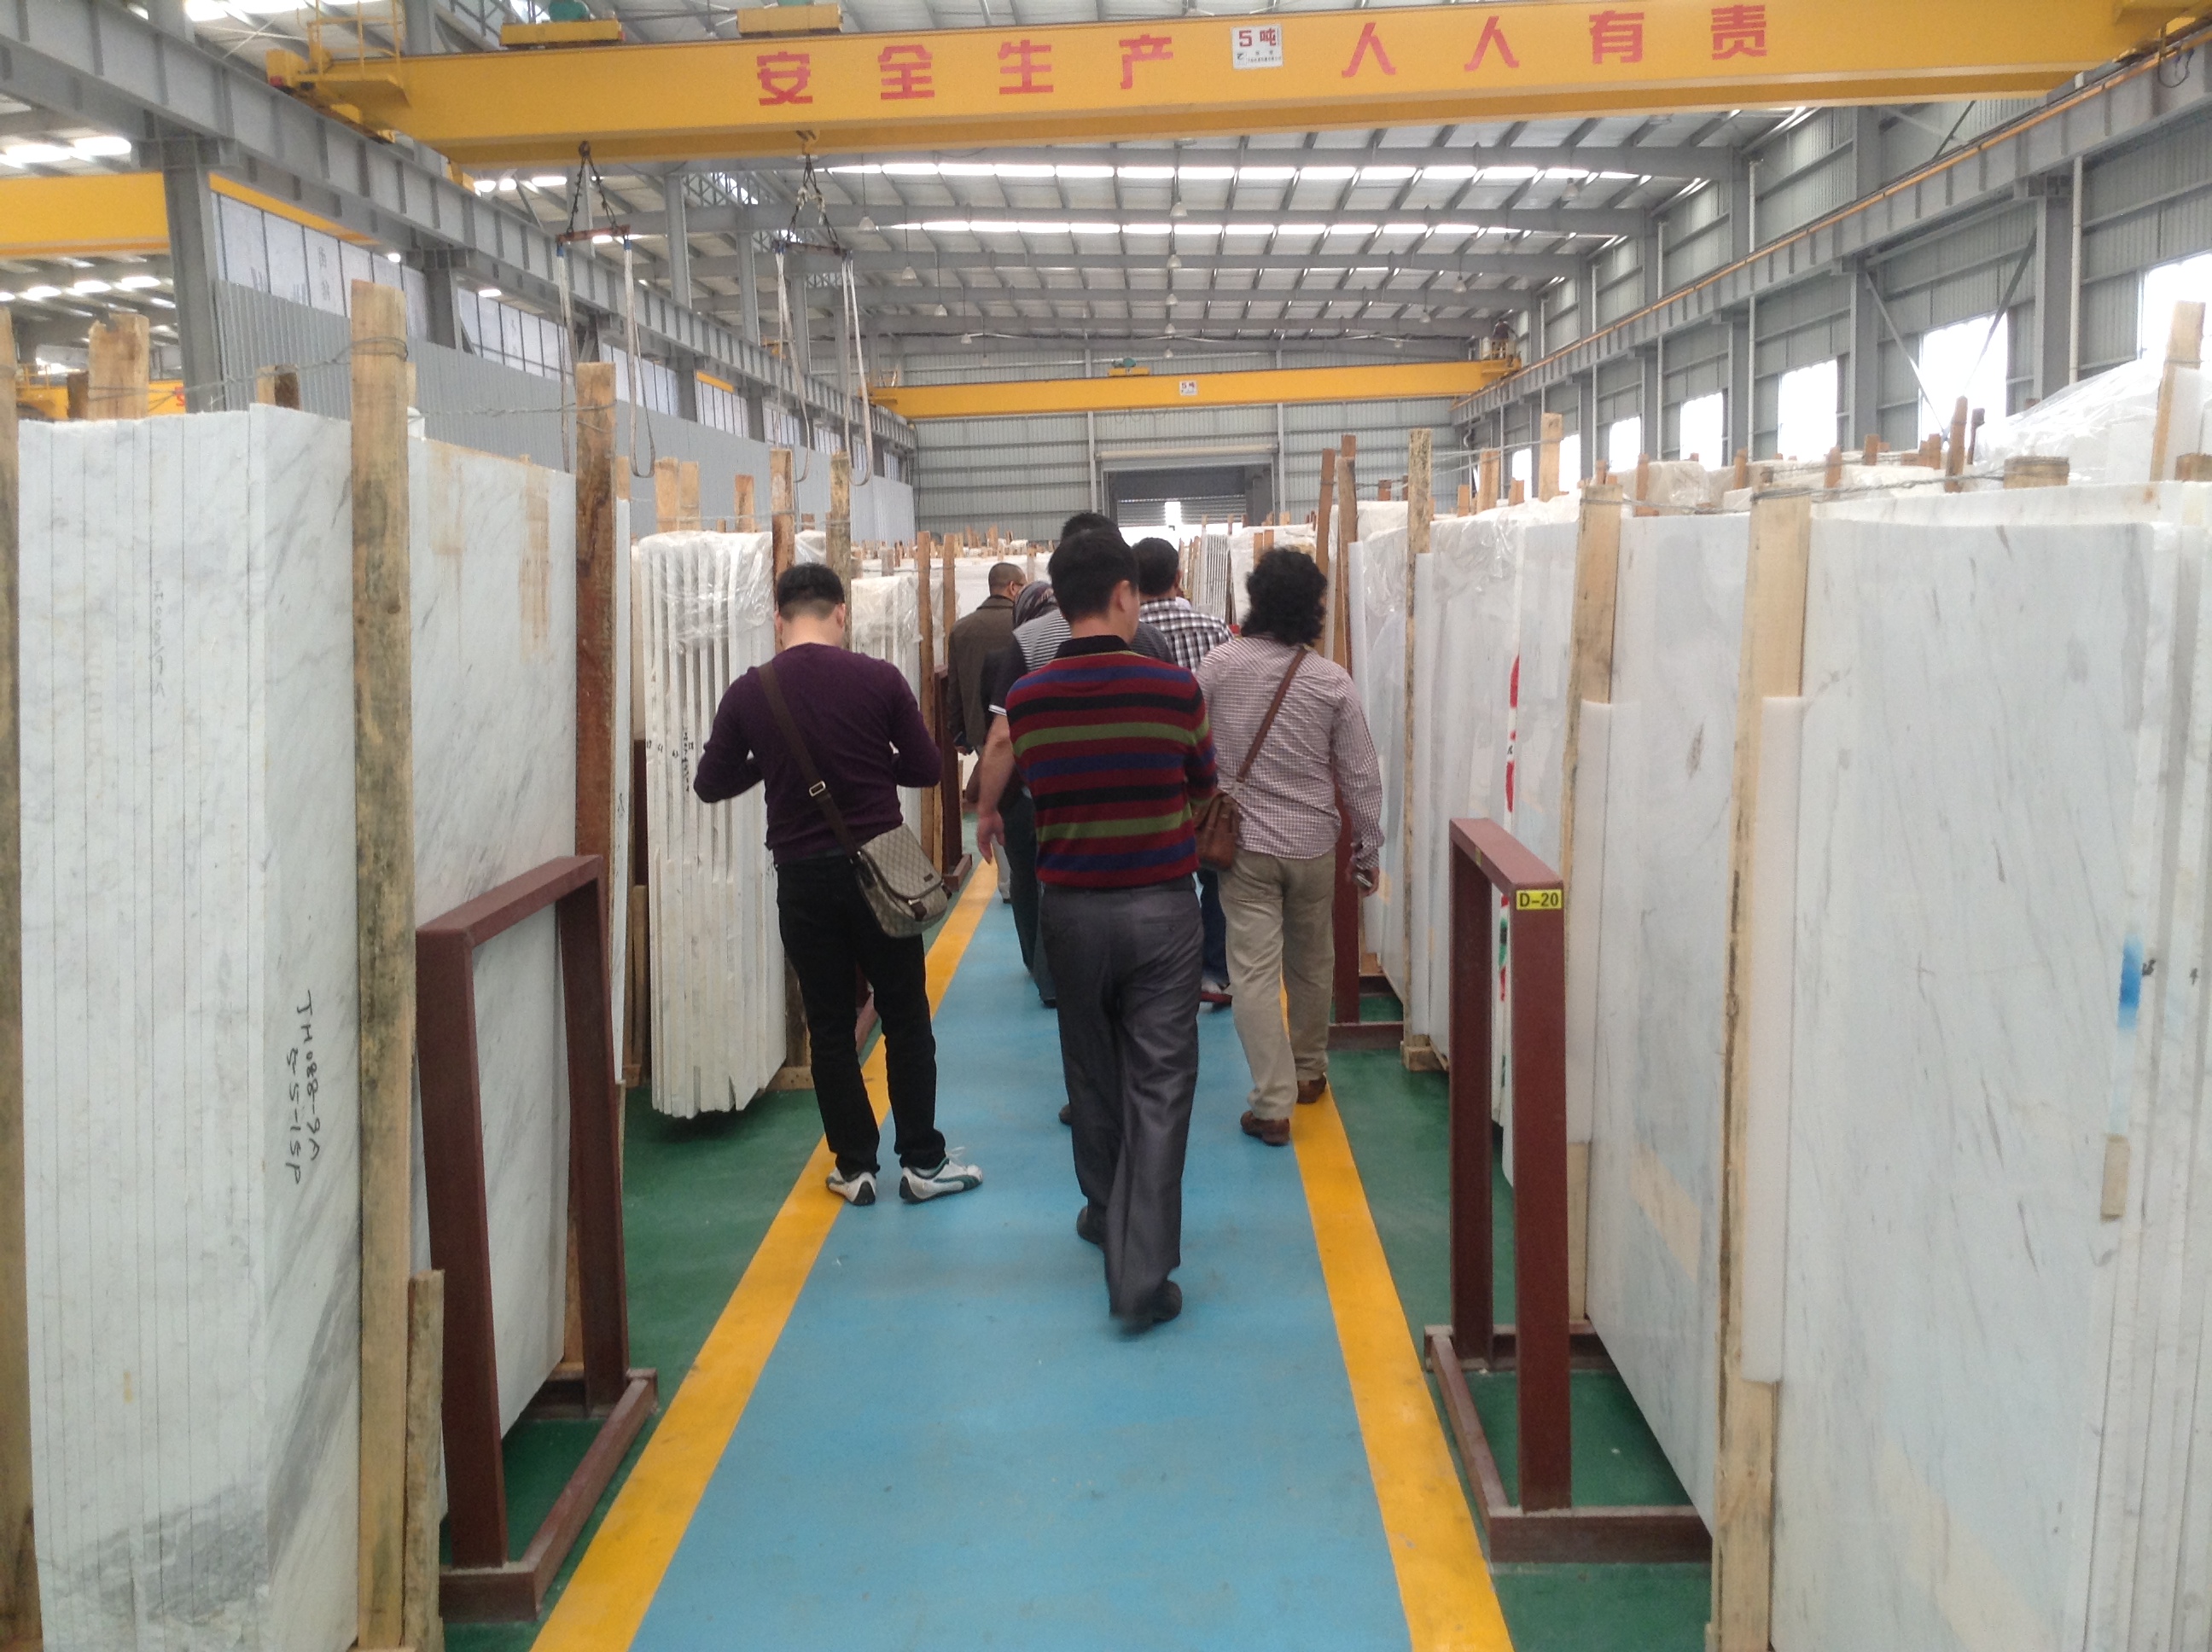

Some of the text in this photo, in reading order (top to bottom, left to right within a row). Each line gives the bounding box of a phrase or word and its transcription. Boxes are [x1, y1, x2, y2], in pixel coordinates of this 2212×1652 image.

[756, 34, 1173, 107] 安全生产
[1341, 4, 1768, 79] 人人有责
[1519, 892, 1559, 907] D-20
